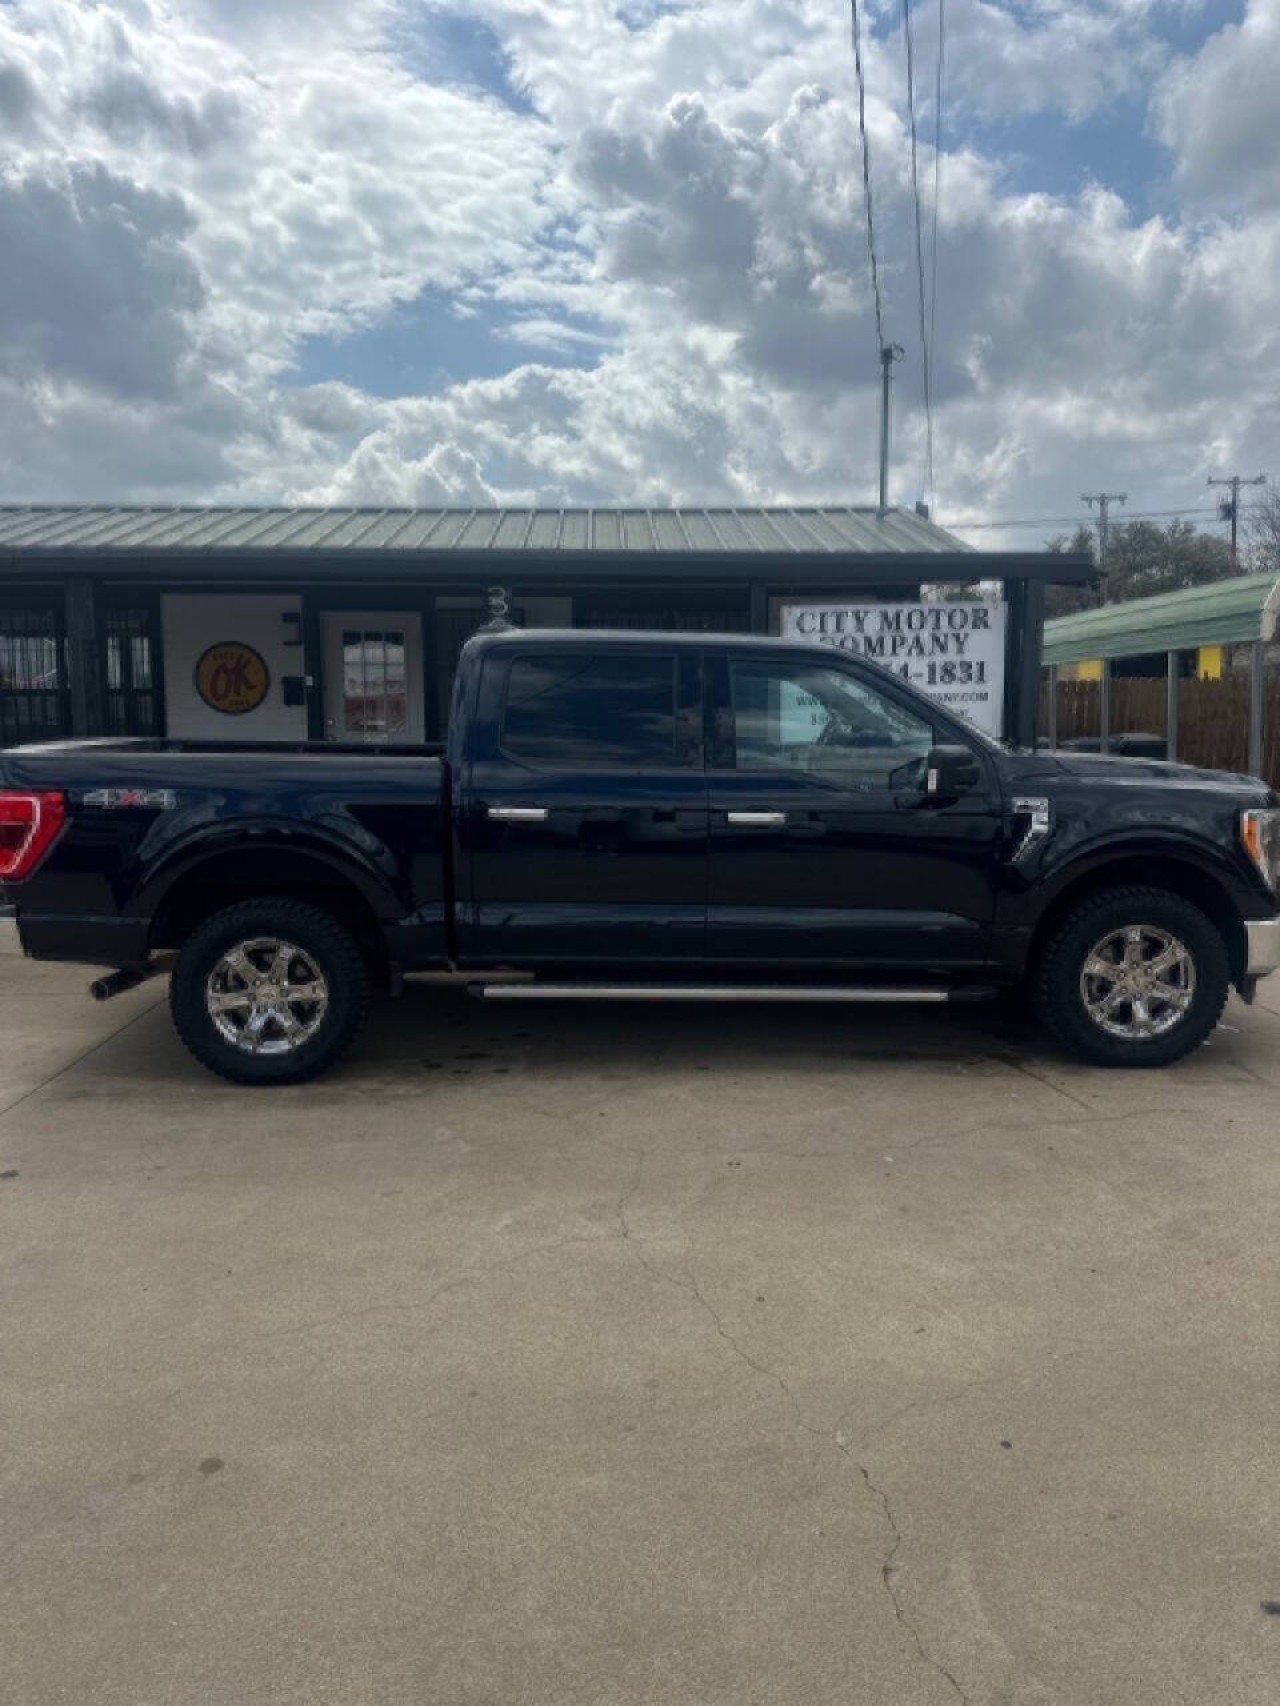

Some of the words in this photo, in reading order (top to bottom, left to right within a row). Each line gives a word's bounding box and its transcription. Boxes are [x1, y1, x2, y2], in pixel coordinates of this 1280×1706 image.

[796, 609, 870, 634] CITY
[880, 608, 992, 630] MOTOR
[209, 655, 254, 699] OK
[880, 660, 985, 685] 4-1831
